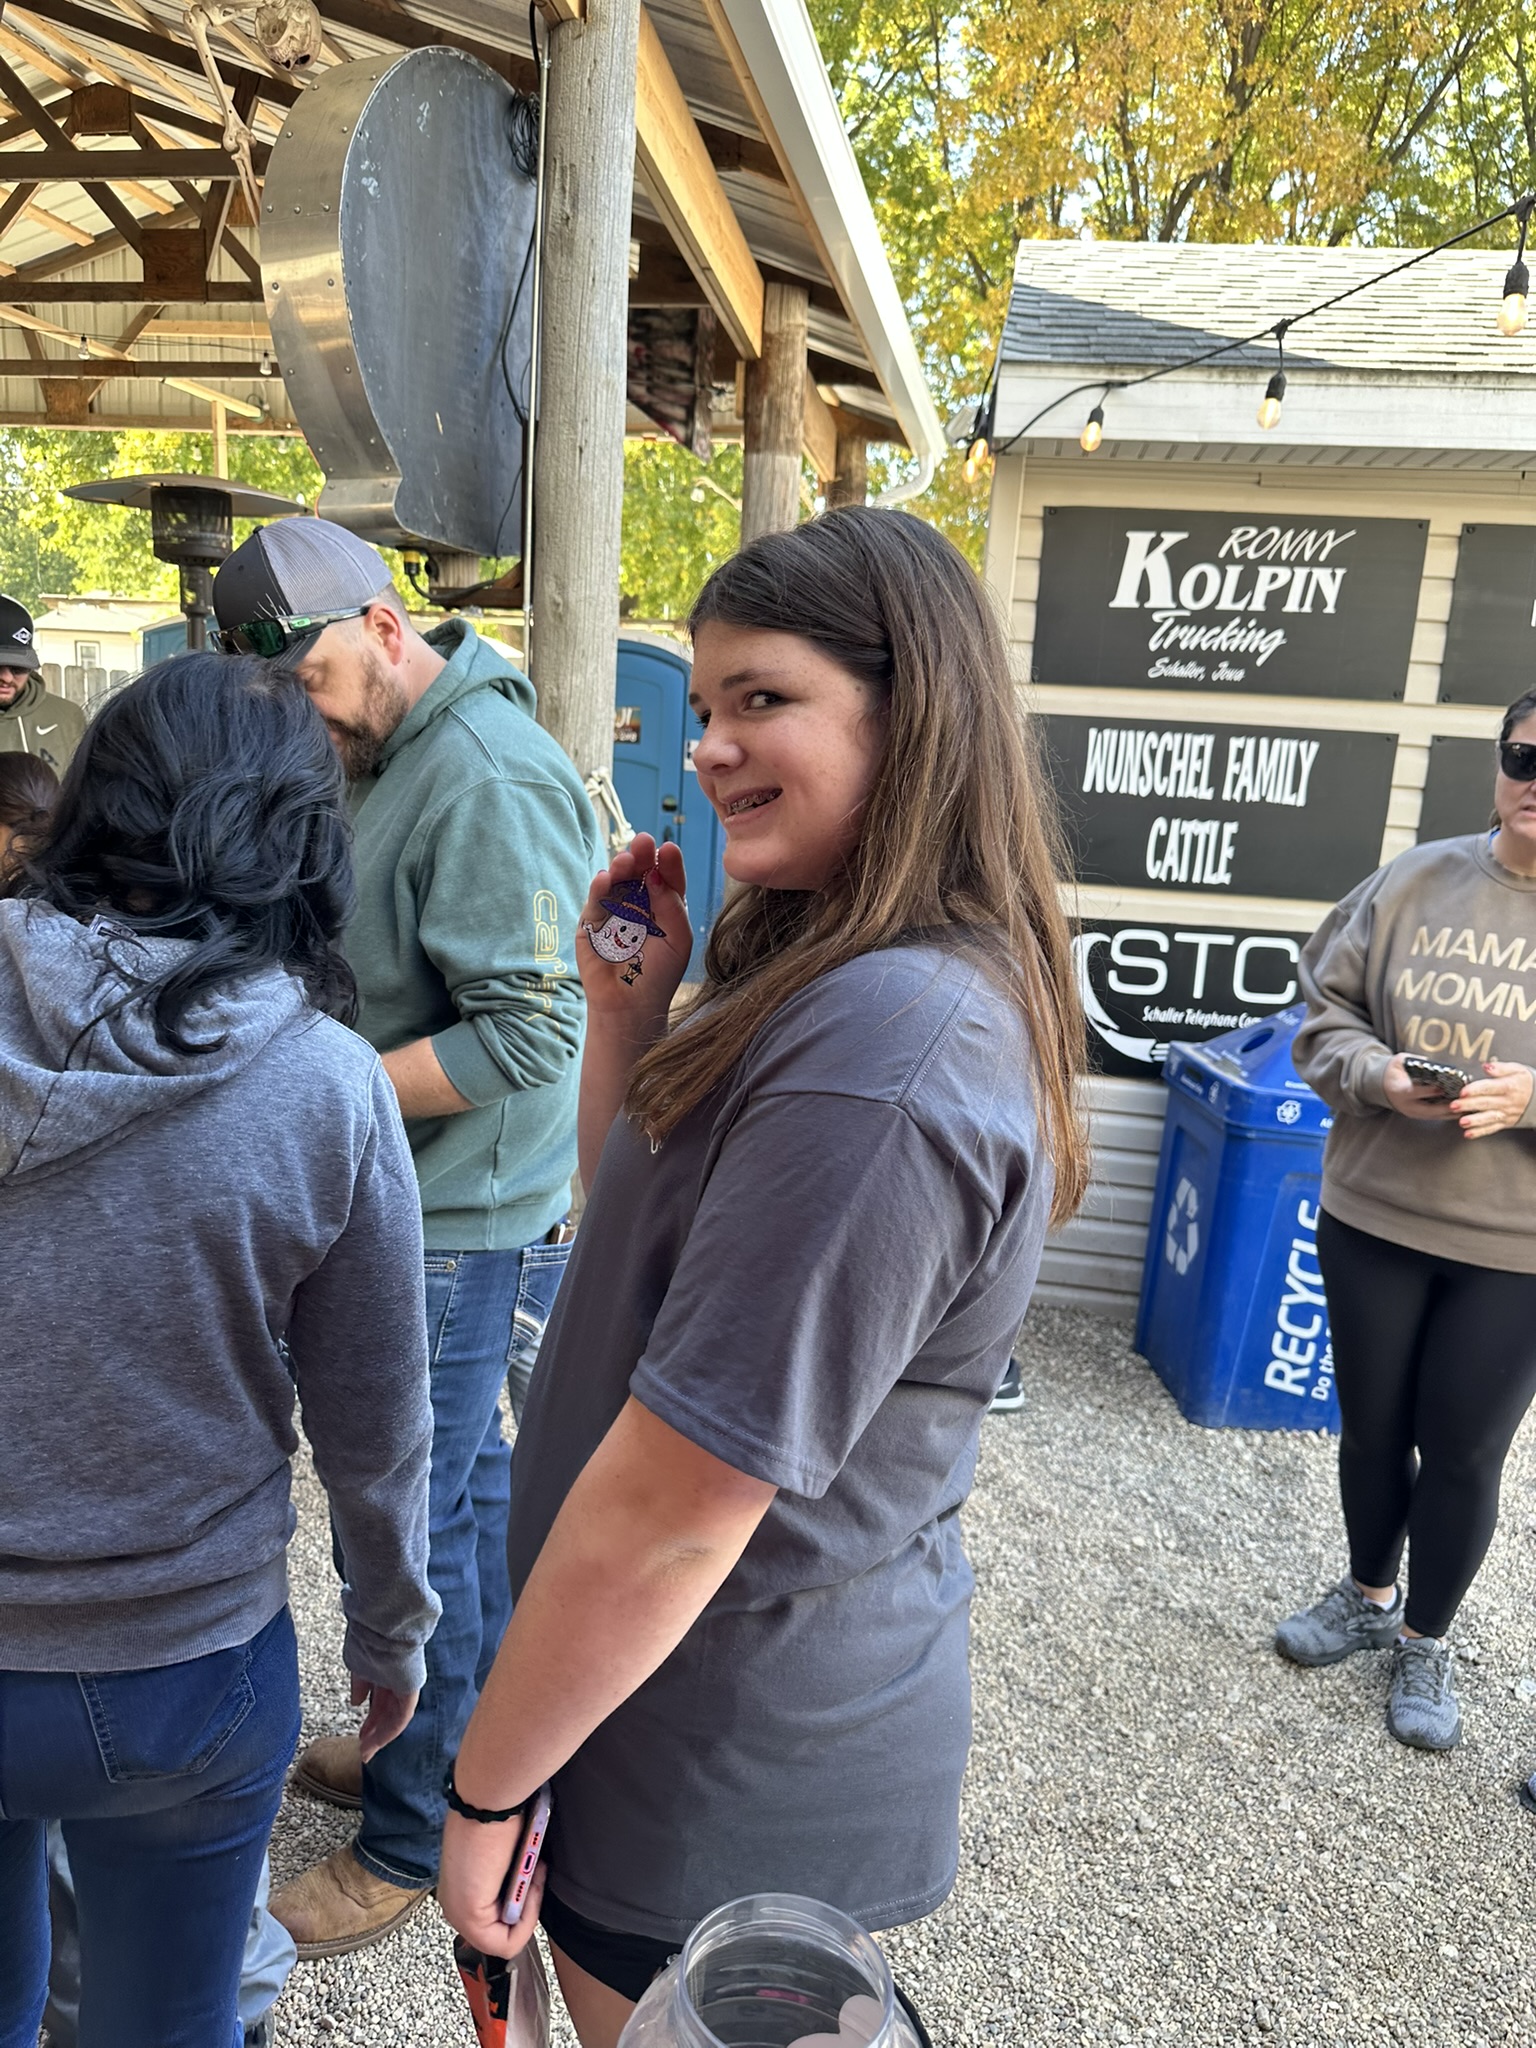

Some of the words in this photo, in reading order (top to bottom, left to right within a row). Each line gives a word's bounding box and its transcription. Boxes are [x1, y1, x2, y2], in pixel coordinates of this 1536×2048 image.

[1218, 526, 1357, 562] RONNY
[1148, 609, 1287, 667] Trucking
[1082, 727, 1214, 801] WUNSCHEL
[1221, 735, 1320, 808] FAMILY
[1145, 816, 1239, 885] CATTLE
[1108, 928, 1299, 1005] STC
[1142, 1005, 1185, 1024] Schaller
[1184, 1008, 1238, 1029] Telephone
[1311, 1375, 1332, 1401] Do
